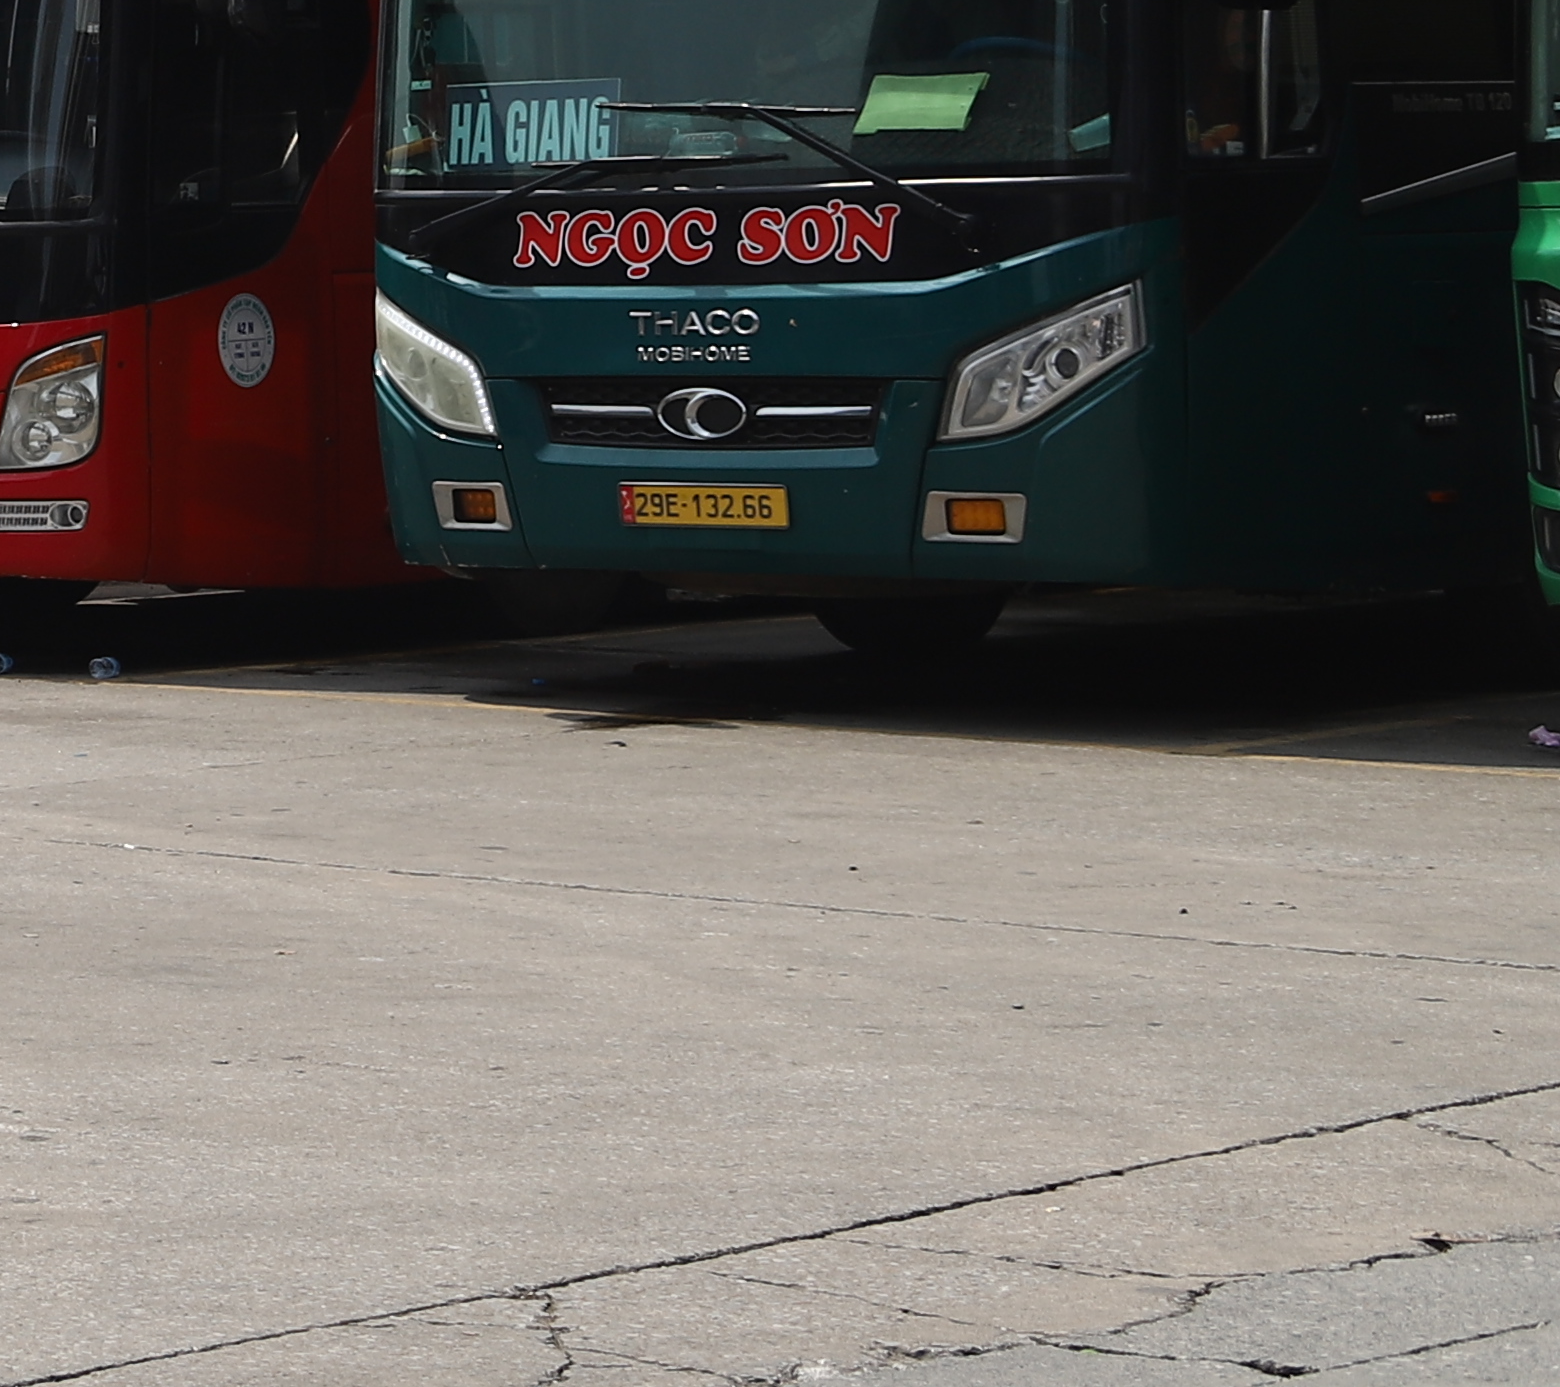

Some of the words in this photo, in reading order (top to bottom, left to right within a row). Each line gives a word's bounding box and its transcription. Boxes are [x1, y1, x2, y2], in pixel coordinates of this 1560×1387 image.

[449, 89, 494, 166] HÀ
[505, 96, 611, 164] GIANG
[513, 207, 717, 279] NGỌC
[737, 198, 901, 266] SƠN
[628, 308, 761, 337] THACO
[637, 345, 752, 362] MOBIHOME
[635, 492, 773, 519] 29E-132.66
